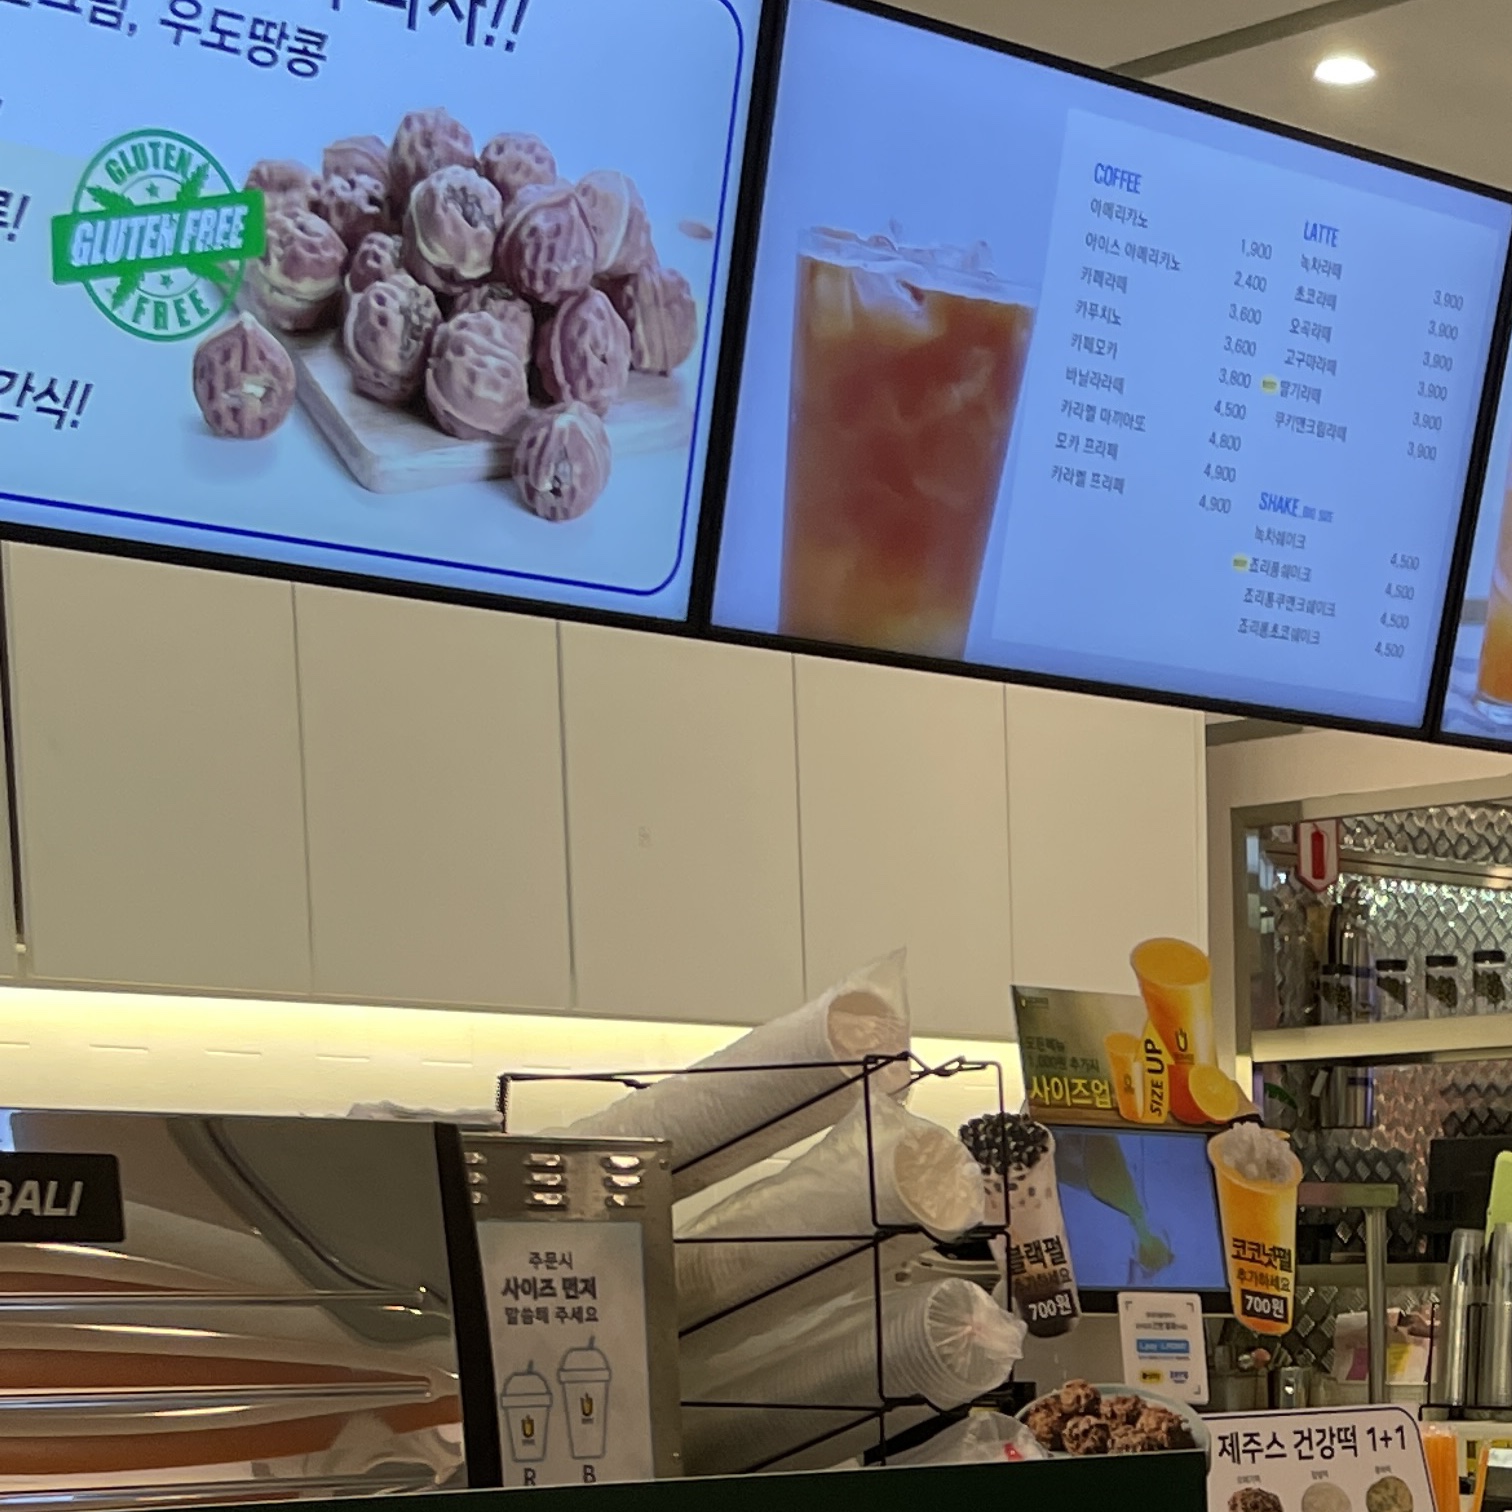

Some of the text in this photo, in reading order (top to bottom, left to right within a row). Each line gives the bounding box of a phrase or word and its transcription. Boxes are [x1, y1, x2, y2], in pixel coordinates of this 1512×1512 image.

[159, 0, 329, 79] 우도땅콩
[104, 141, 195, 186] GLUTEN
[1094, 163, 1142, 194] COFFEE
[70, 204, 250, 269] GLUTEN FREE
[1090, 198, 1273, 260] 아메리카노 1,900
[1303, 220, 1339, 248] LATTE
[1085, 232, 1267, 292] 아이스 아메리카노 2,400
[1081, 266, 1128, 294] 카페라떼
[127, 286, 212, 333] FREE
[1075, 299, 1121, 326] 카푸치노
[1294, 285, 1338, 312] 초코라떼
[1071, 333, 1118, 360] 카페모카
[1284, 349, 1337, 376] 고구마라떼
[1066, 366, 1246, 421] 바닐라라떼 4,500
[1061, 399, 1096, 423] 카라멜
[1055, 432, 1080, 452] 모카
[1051, 465, 1087, 488] 카라멜
[1258, 492, 1300, 517] SHAKE
[1144, 1038, 1165, 1116] SIZE UP
[1030, 1075, 1113, 1109] 사이즈업
[529, 1251, 573, 1270] 주문시
[1010, 1235, 1067, 1276] 블랙펄
[1231, 1237, 1292, 1274] 코코넛펄
[502, 1276, 598, 1300] 사이즈 먼저
[1236, 1267, 1291, 1293] 추가하세요
[554, 1306, 599, 1324] 주세요
[1028, 1291, 1072, 1322] 700원
[1244, 1294, 1284, 1318] 700원
[1218, 1424, 1406, 1465] 제주스 건강떡 1+1
[524, 1464, 596, 1486] R B
